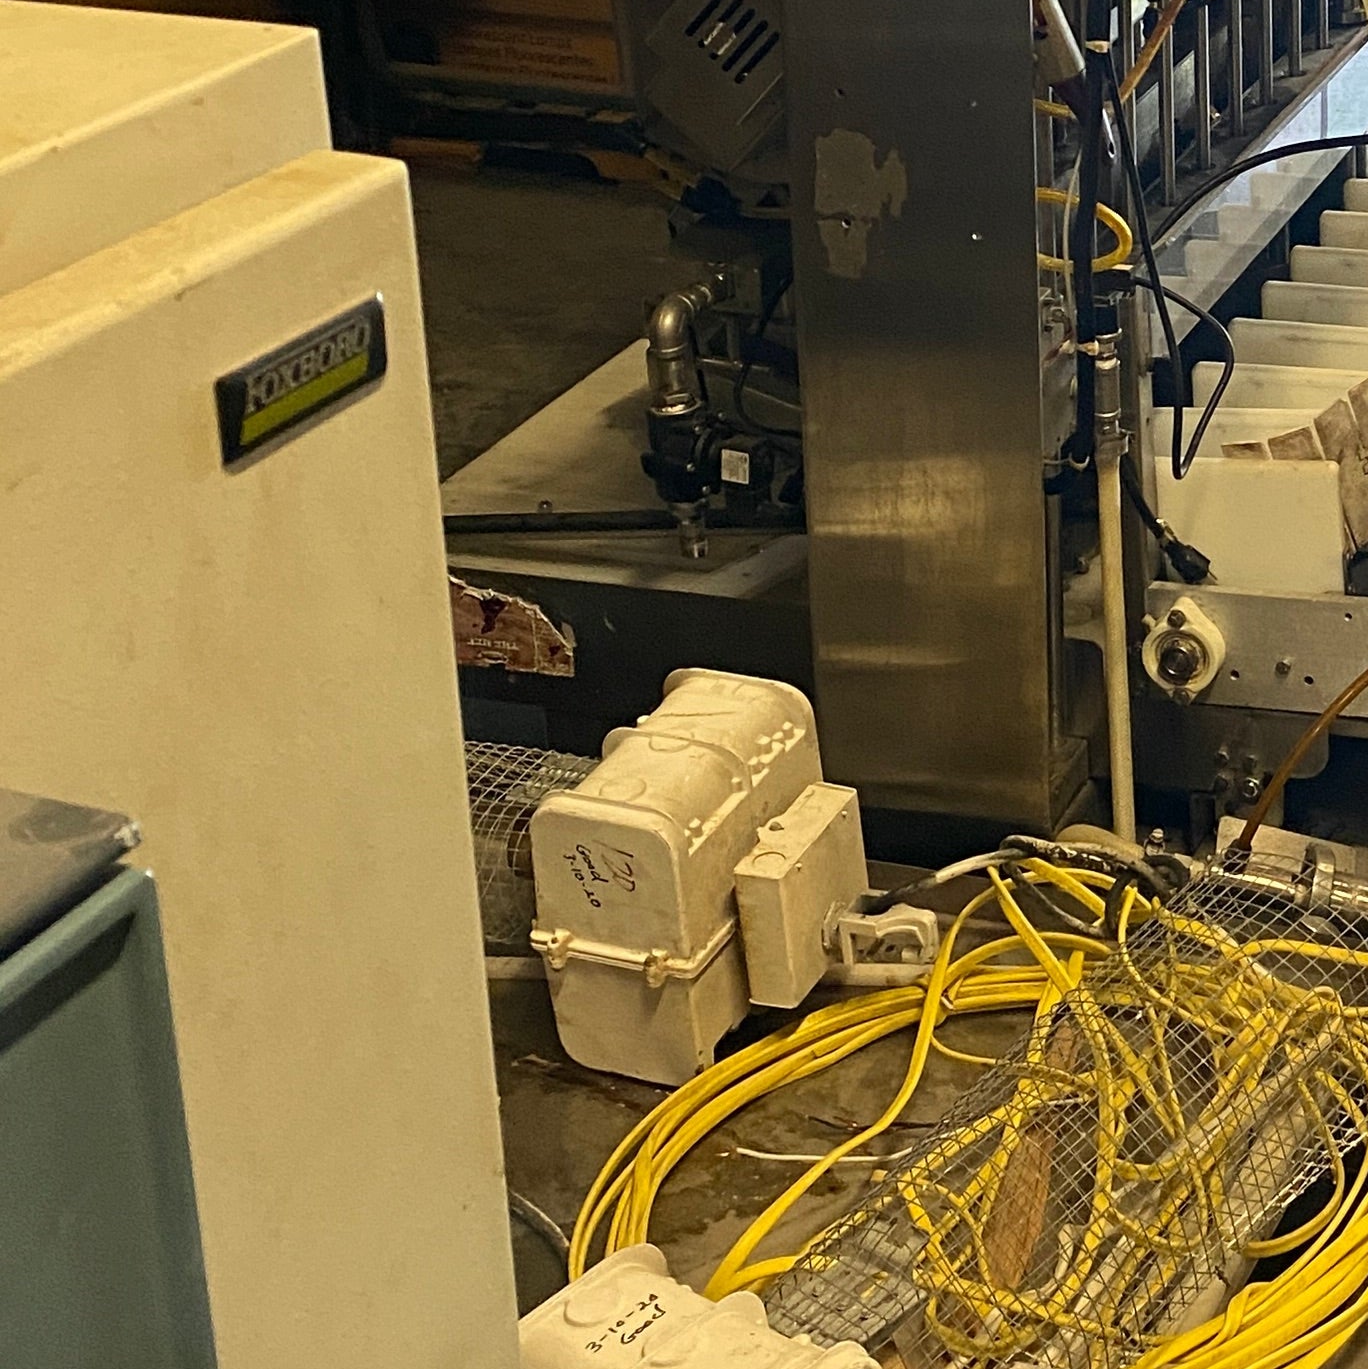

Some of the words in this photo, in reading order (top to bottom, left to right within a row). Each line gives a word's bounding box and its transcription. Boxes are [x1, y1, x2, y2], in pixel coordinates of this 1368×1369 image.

[246, 319, 370, 414] FOXBORO
[576, 844, 609, 883] Good
[585, 1293, 658, 1353] 3-10-20
[620, 1303, 666, 1345] Good
